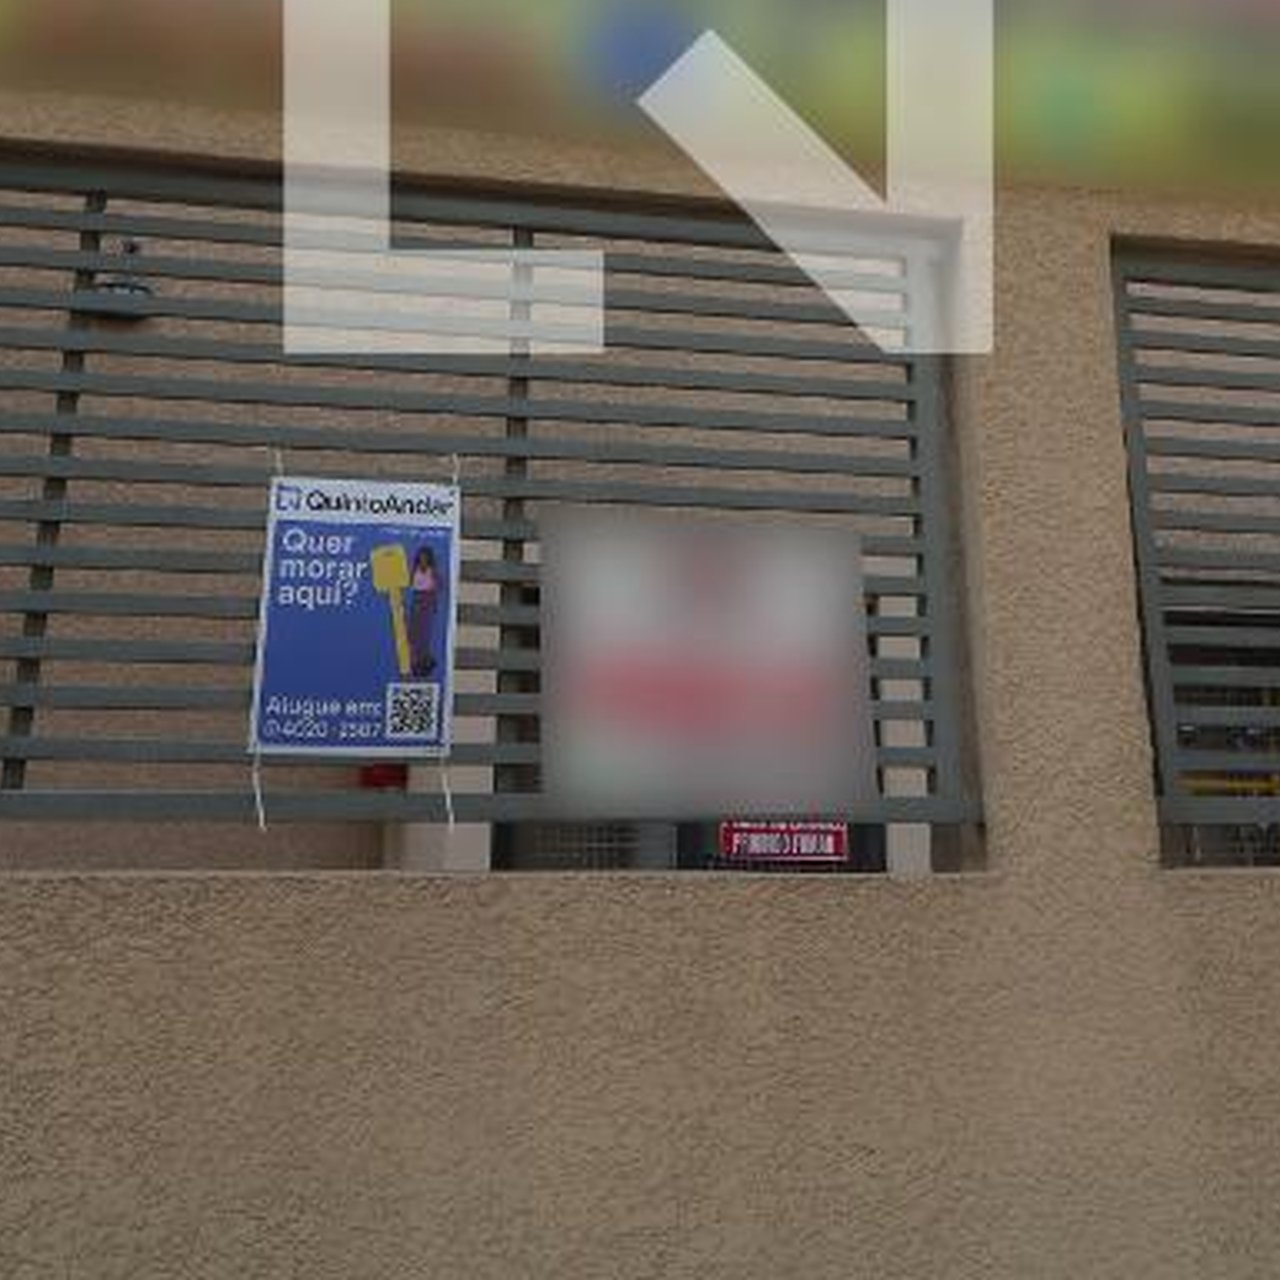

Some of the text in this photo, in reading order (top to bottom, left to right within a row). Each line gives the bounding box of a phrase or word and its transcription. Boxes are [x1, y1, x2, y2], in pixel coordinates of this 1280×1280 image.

[306, 490, 455, 517] QuintoAndar
[282, 528, 356, 554] Quer
[279, 558, 369, 580] morar
[278, 580, 359, 611] aqui?
[265, 695, 342, 719] Alugue
